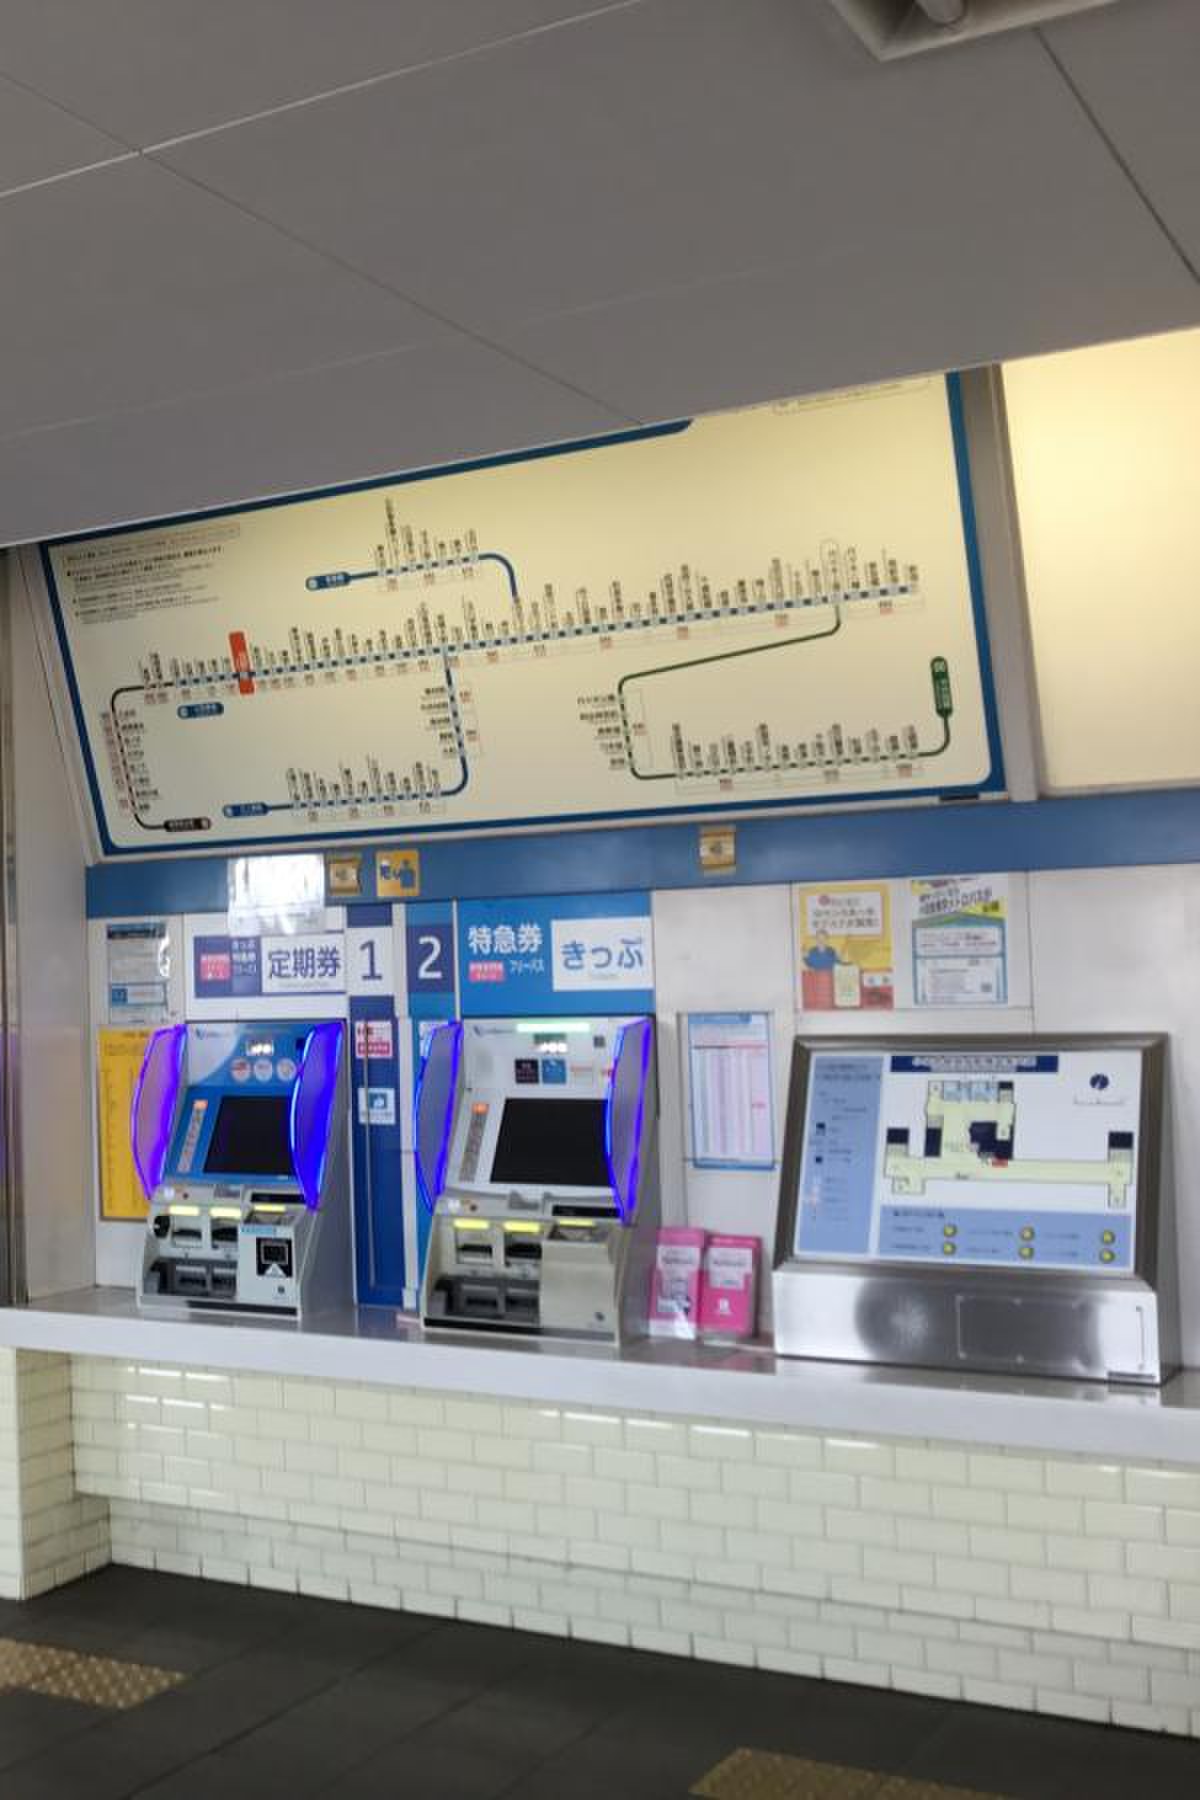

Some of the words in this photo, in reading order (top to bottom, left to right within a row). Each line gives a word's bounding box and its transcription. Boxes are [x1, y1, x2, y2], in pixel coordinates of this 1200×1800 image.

[468, 923, 543, 955] 特急券
[560, 938, 643, 970] きっぷ
[267, 946, 341, 979] 定期券
[359, 939, 383, 981] 1
[417, 933, 443, 980] 2
